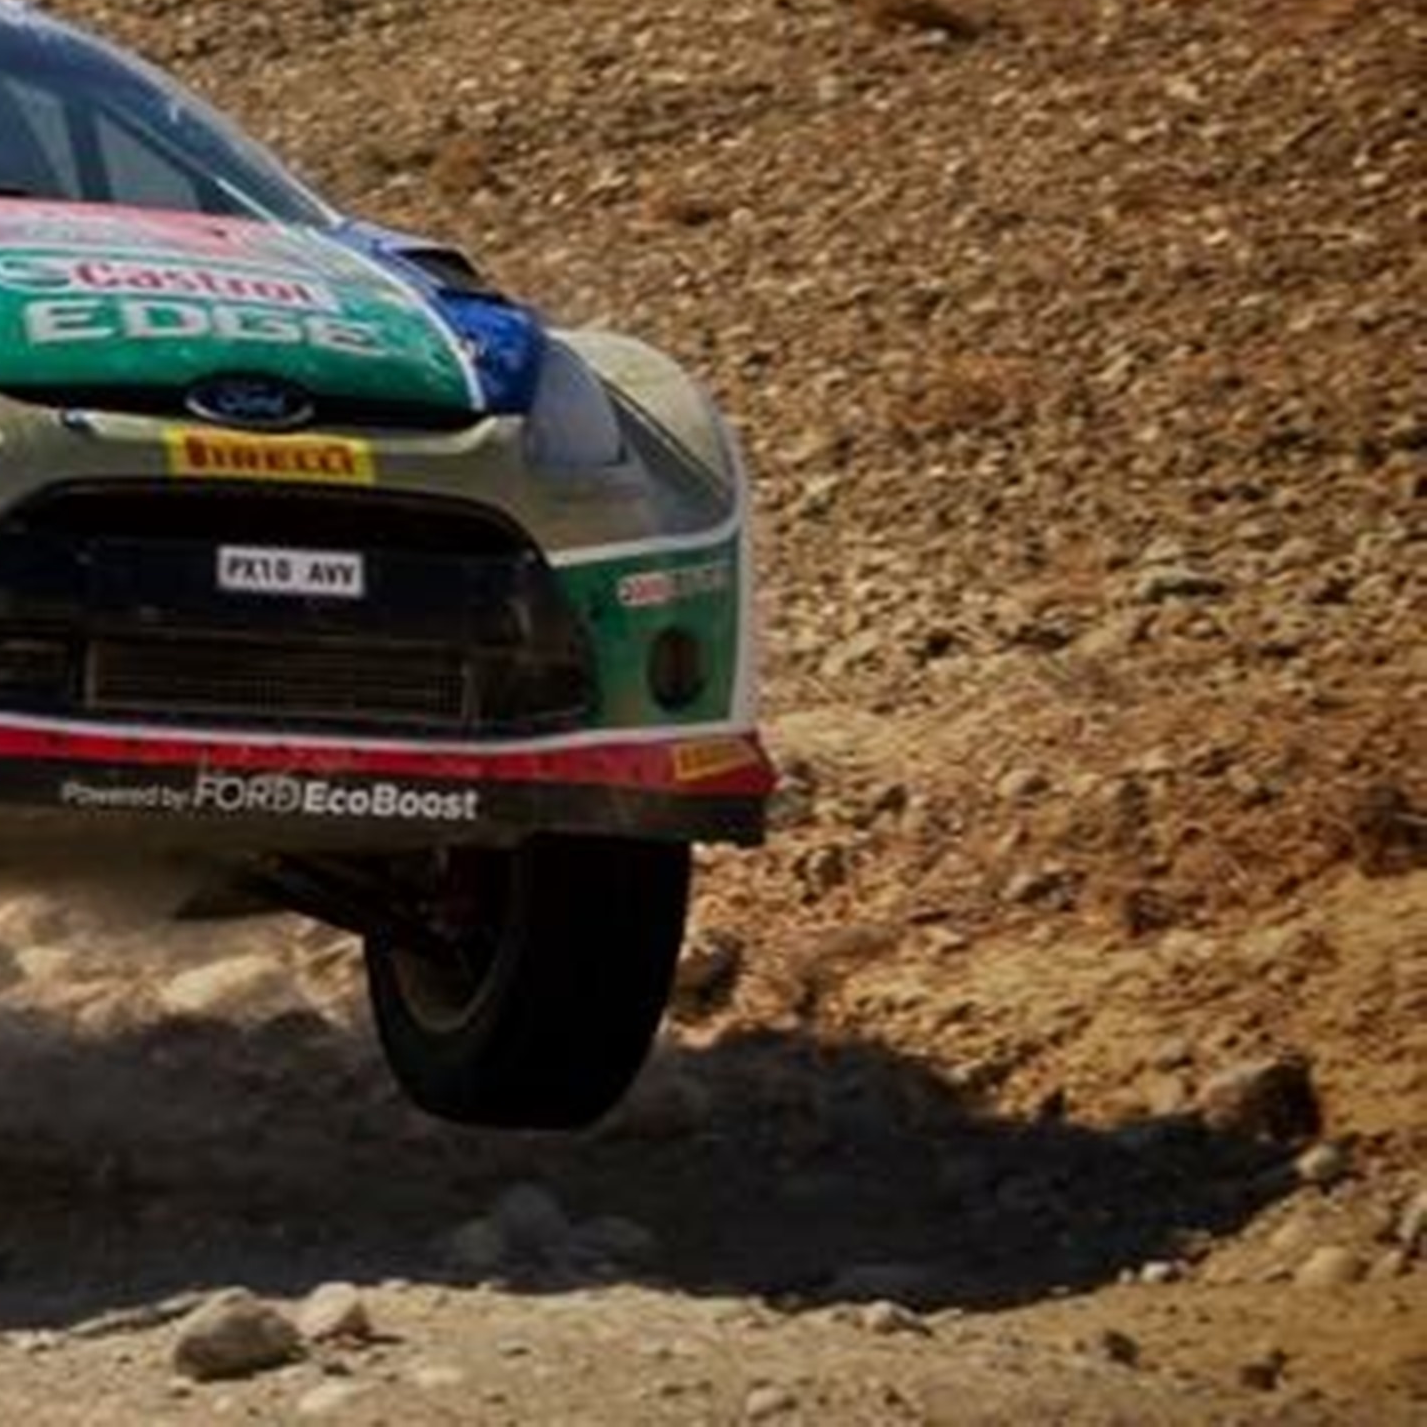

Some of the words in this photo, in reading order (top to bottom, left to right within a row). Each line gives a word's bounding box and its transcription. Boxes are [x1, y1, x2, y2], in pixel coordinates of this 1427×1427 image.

[73, 261, 313, 304] Castrol
[23, 298, 385, 358] EDGE
[184, 433, 356, 476] PIRELLI
